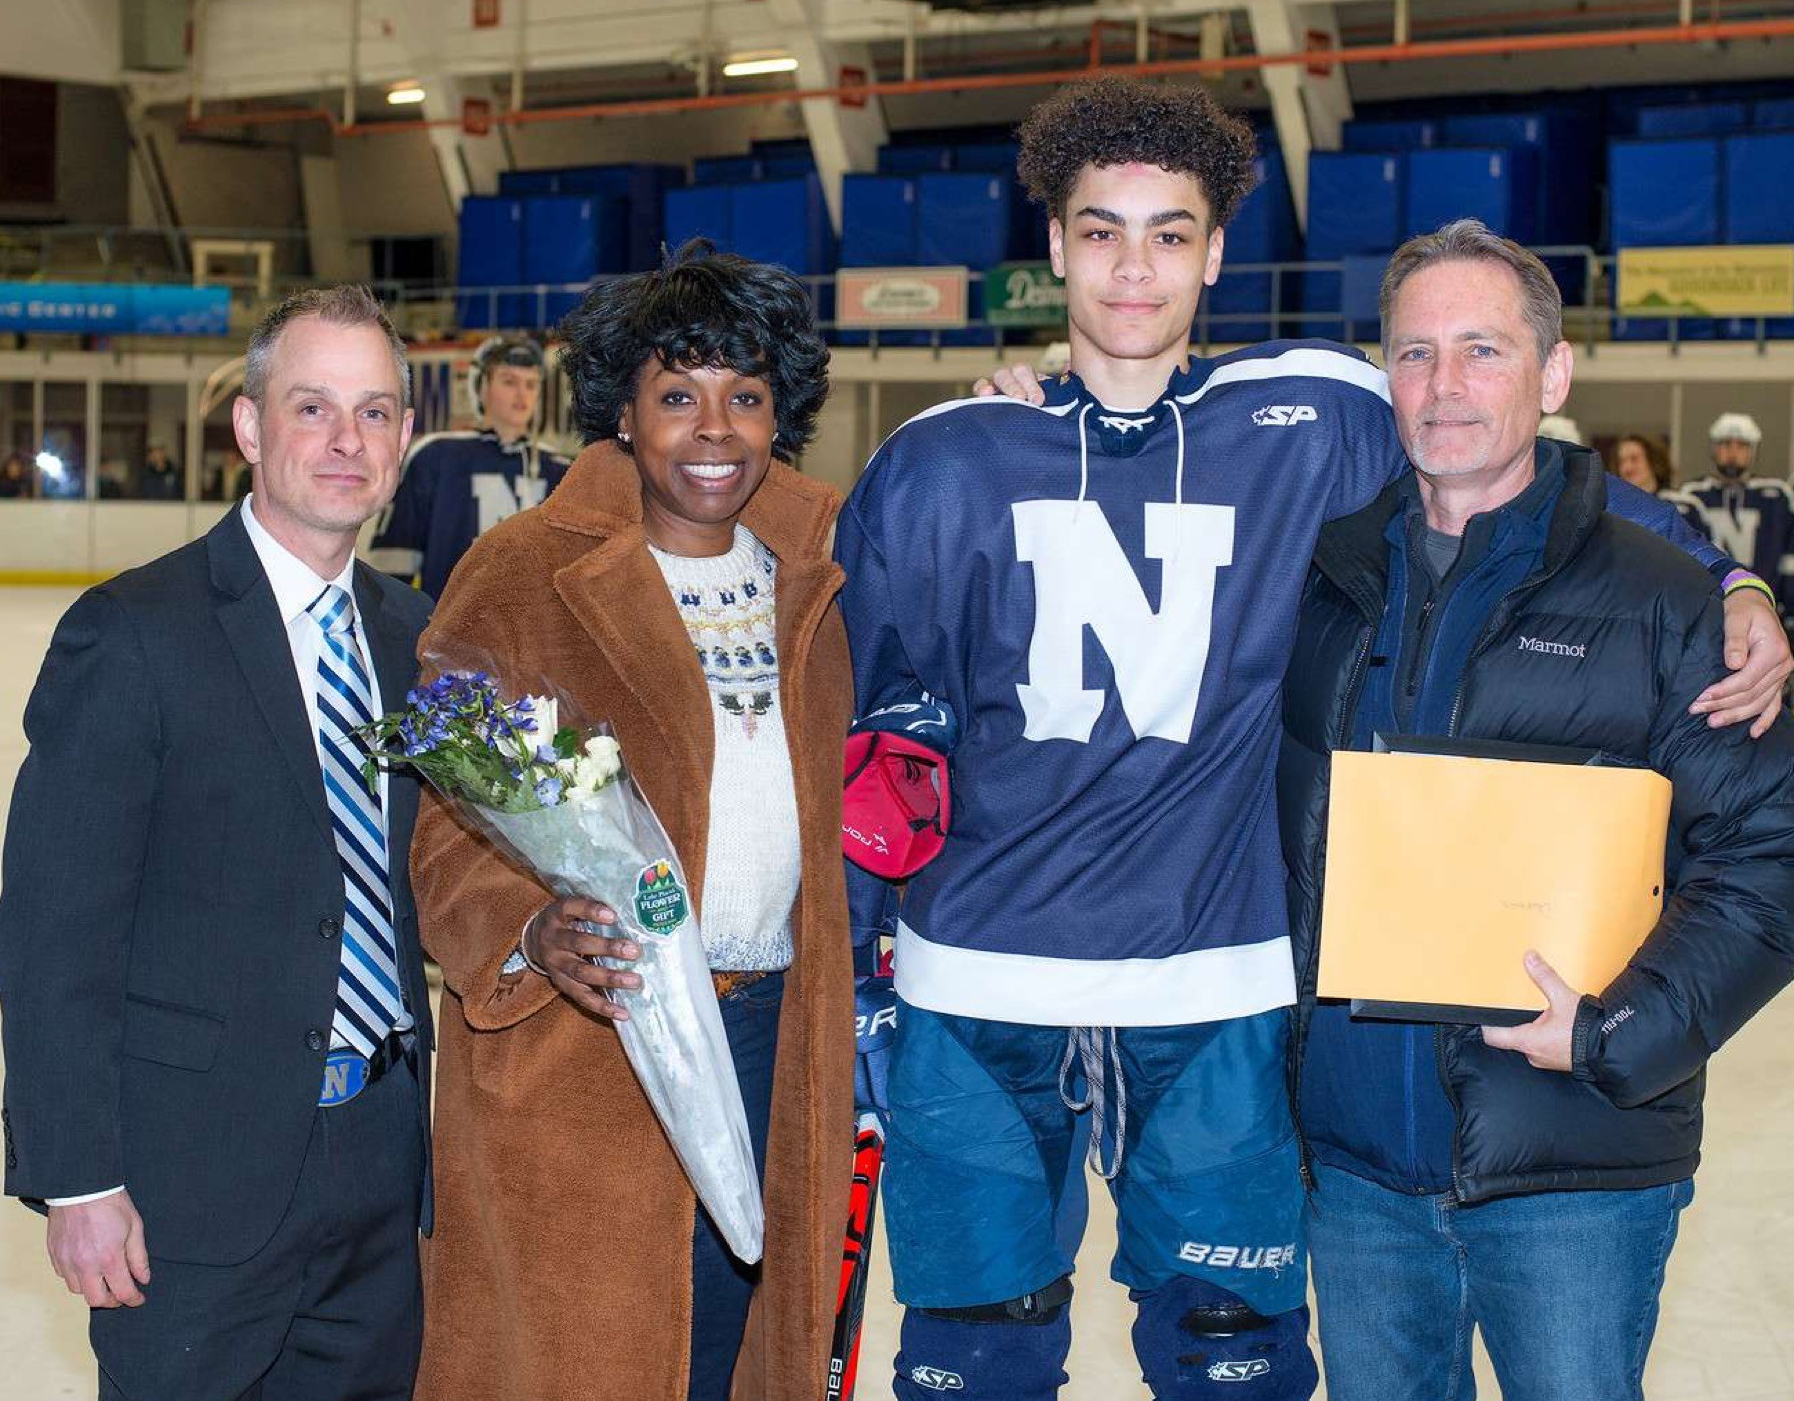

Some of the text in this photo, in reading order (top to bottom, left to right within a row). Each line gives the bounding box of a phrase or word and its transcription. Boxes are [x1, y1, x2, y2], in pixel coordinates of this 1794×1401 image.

[1256, 405, 1318, 426] SP
[1011, 499, 1235, 744] N
[1518, 636, 1586, 657] Marmot
[640, 893, 681, 910] FLOWER
[652, 909, 675, 922] GIFT
[324, 1063, 351, 1099] N
[1179, 1241, 1297, 1269] BAUER
[915, 1365, 963, 1390] SP
[1211, 1359, 1270, 1382] SP
